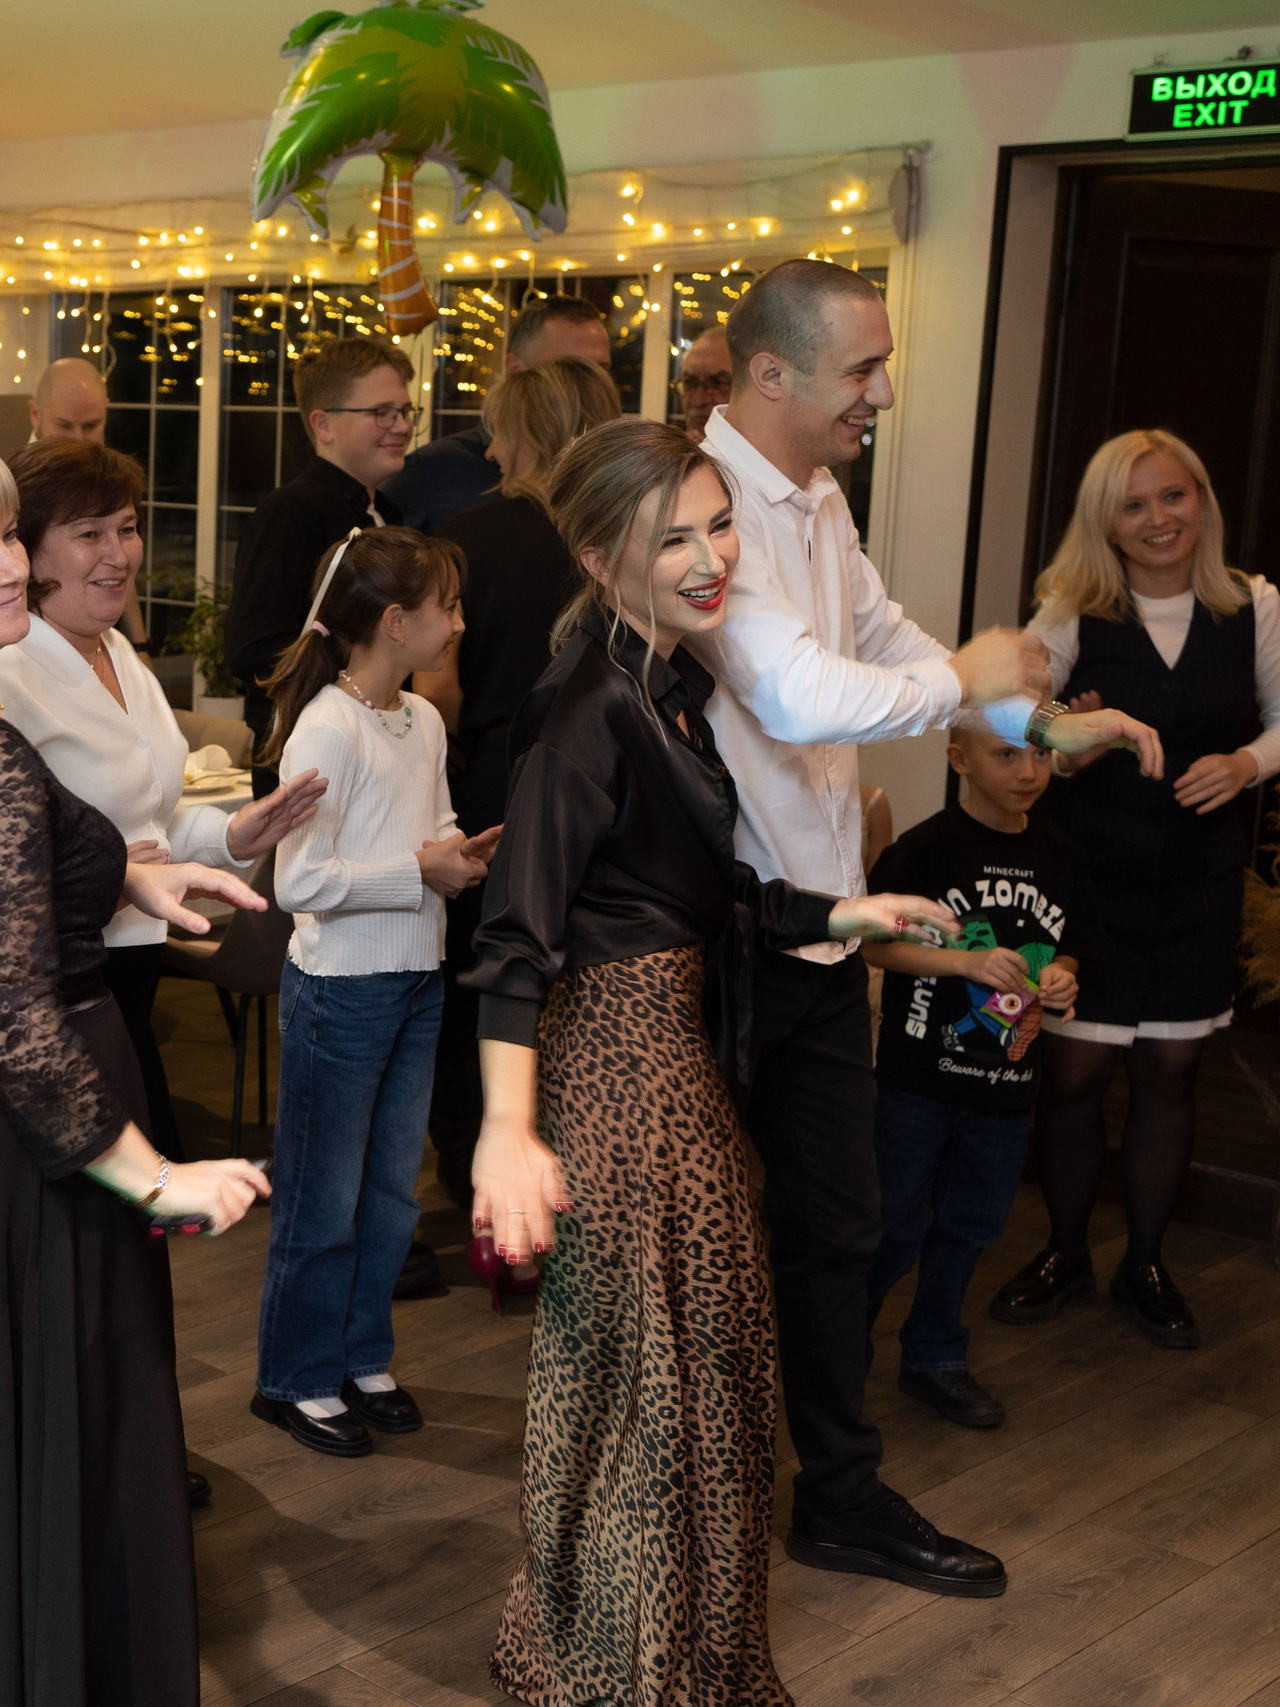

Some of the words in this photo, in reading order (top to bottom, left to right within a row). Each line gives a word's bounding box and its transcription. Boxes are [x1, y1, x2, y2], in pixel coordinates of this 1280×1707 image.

[1151, 69, 1276, 101] ВЫХОД
[1172, 100, 1249, 128] EXIT
[983, 865, 1034, 878] MINECRAFT
[938, 1057, 986, 1077] Beware
[987, 1066, 1002, 1085] of
[1002, 1068, 1020, 1082] the
